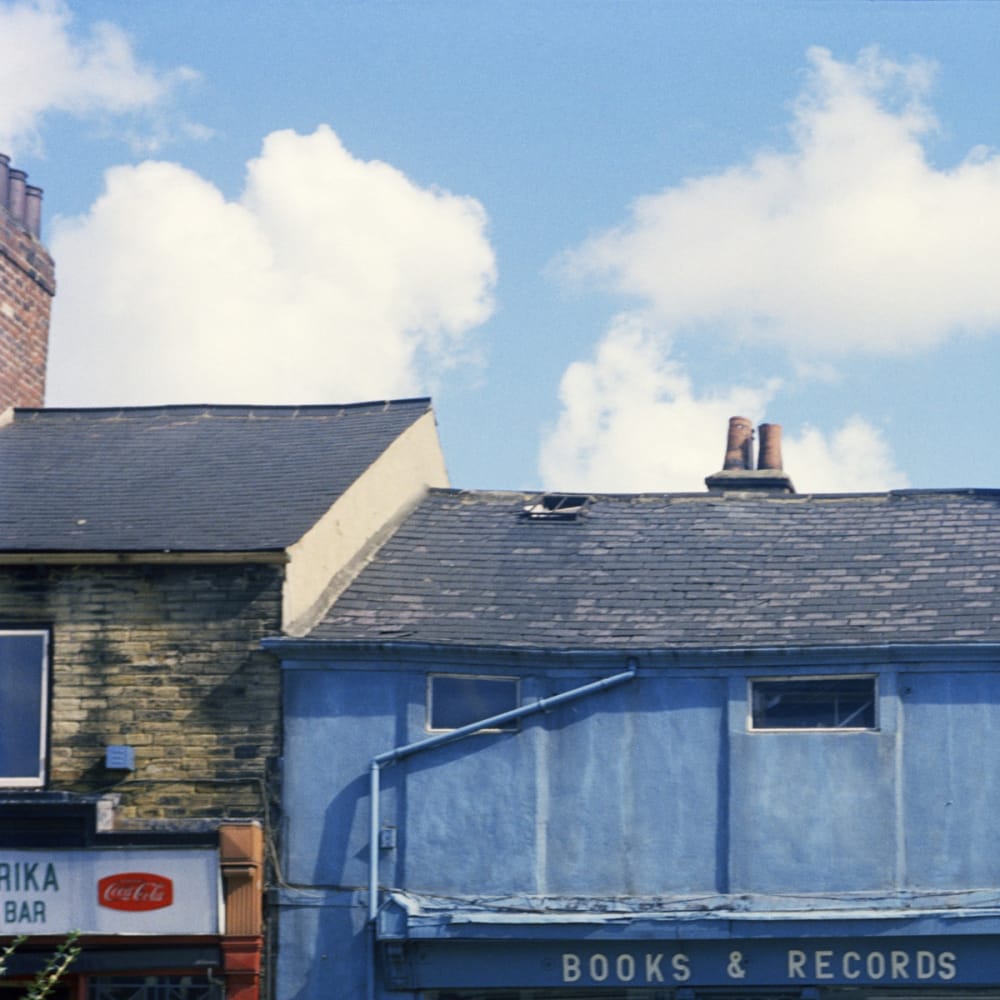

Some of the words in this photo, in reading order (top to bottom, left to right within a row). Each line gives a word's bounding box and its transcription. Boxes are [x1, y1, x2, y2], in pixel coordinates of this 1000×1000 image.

[5, 901, 46, 923] BAR
[562, 953, 691, 982] BOOKS
[727, 950, 746, 979] &
[788, 950, 957, 980] RECORDS
